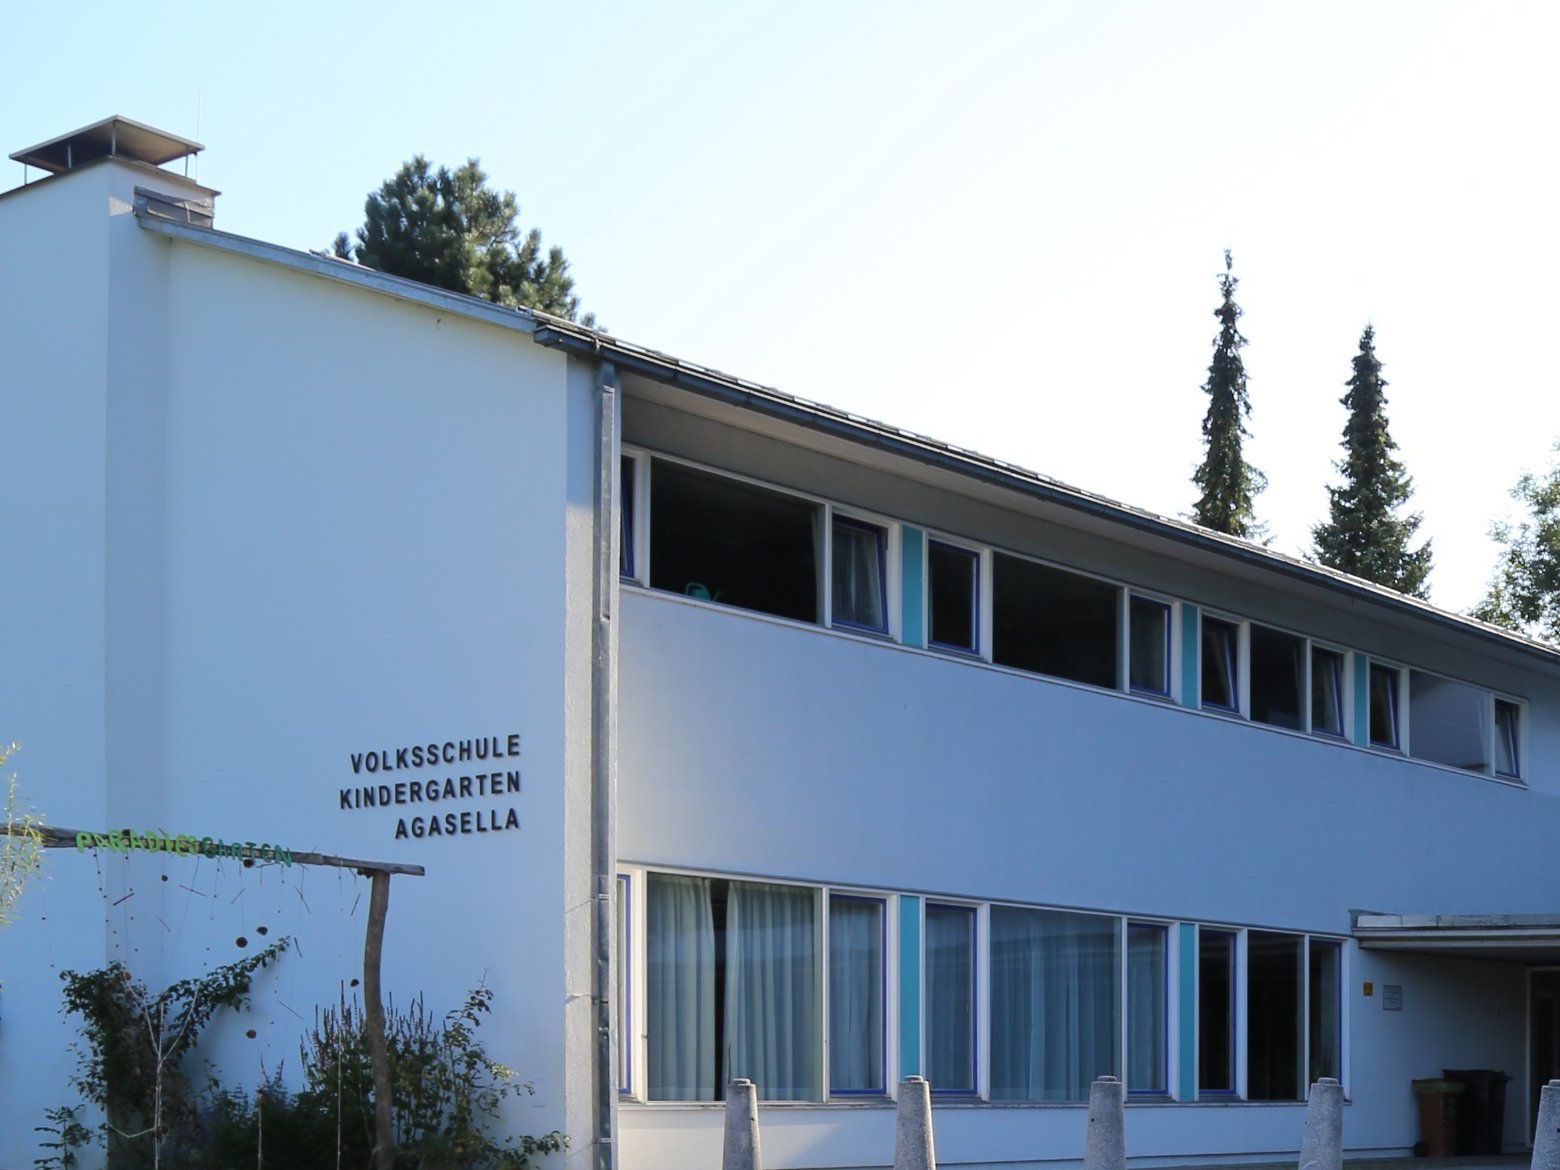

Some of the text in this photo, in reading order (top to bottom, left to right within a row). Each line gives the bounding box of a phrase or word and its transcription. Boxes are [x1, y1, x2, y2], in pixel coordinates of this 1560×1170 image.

[350, 734, 521, 774] VOLKSSCHULE
[340, 770, 521, 809] KINDERGARTEN
[394, 807, 521, 840] AGASELLA
